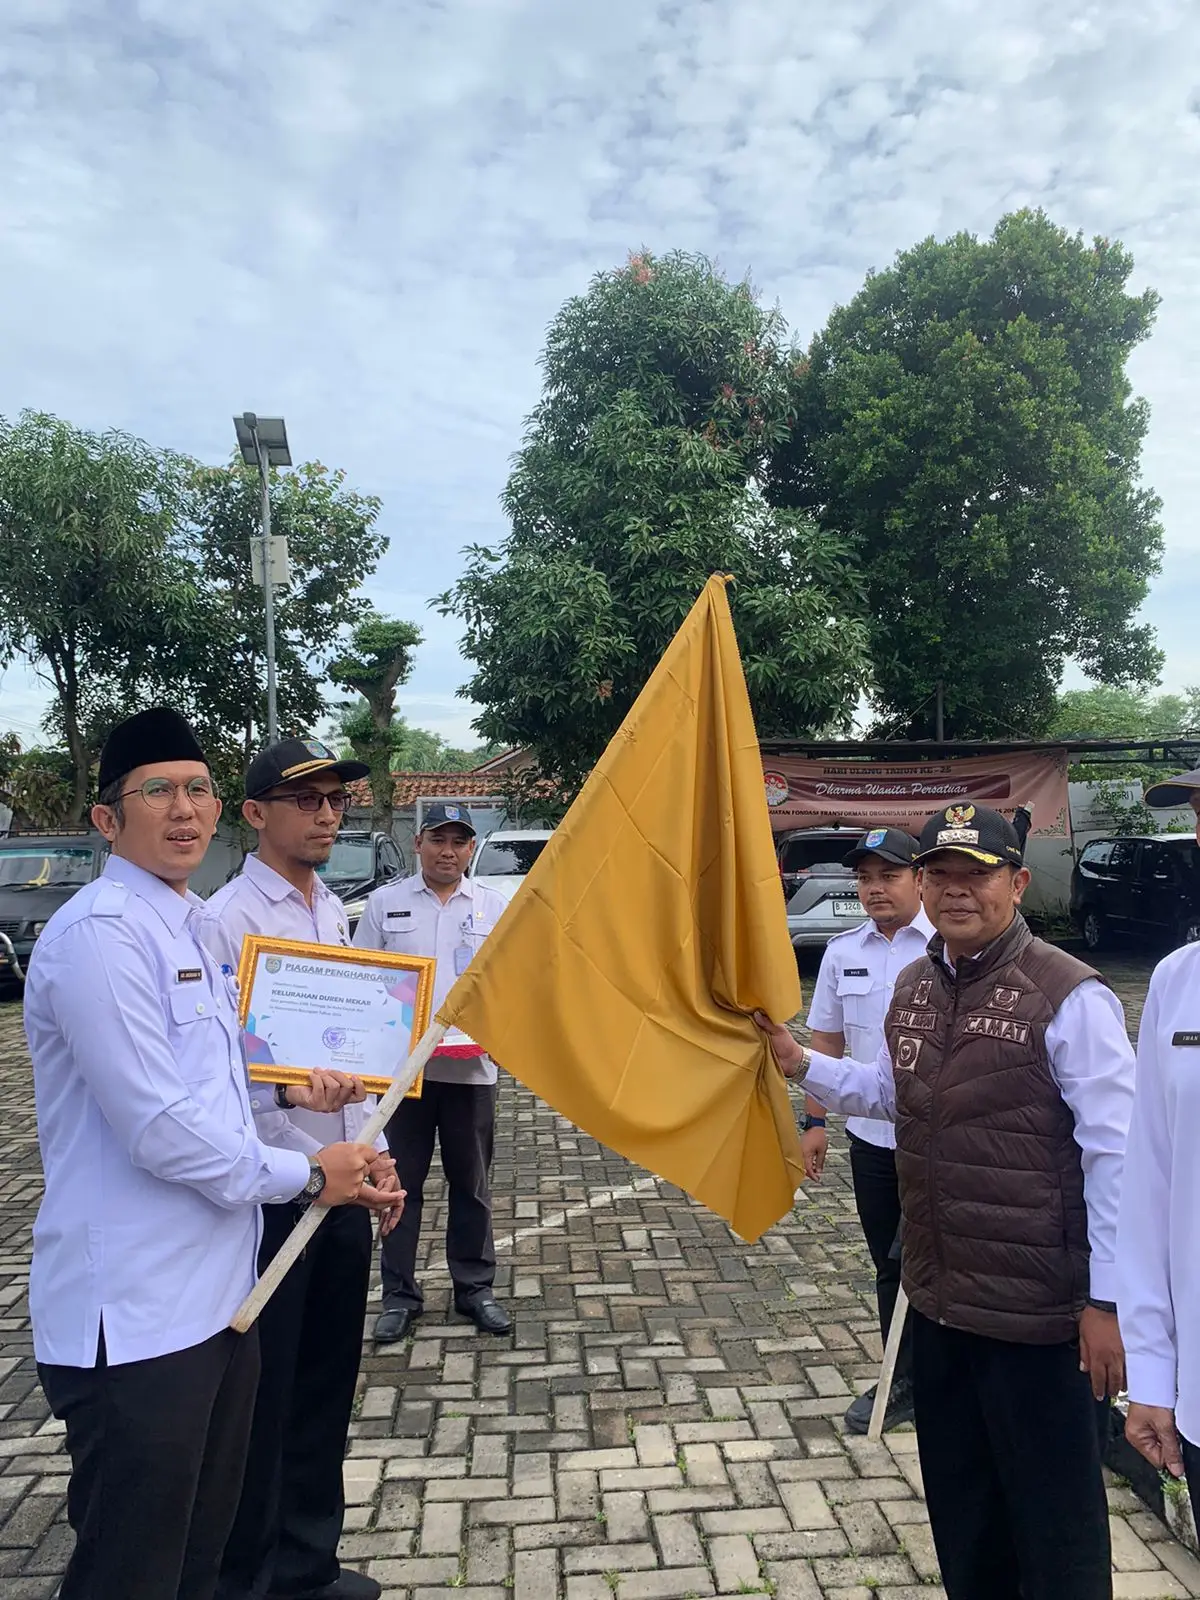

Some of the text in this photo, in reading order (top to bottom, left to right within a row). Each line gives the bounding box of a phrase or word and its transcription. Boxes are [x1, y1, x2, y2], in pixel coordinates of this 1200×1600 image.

[823, 767, 847, 775] HARI
[815, 782, 968, 796] Dharma Wanita Persatuan
[285, 963, 397, 984] PIAGAM PENGHARGAAN
[271, 989, 318, 1000] KELURAHAN
[966, 1017, 1026, 1041] CAMAT
